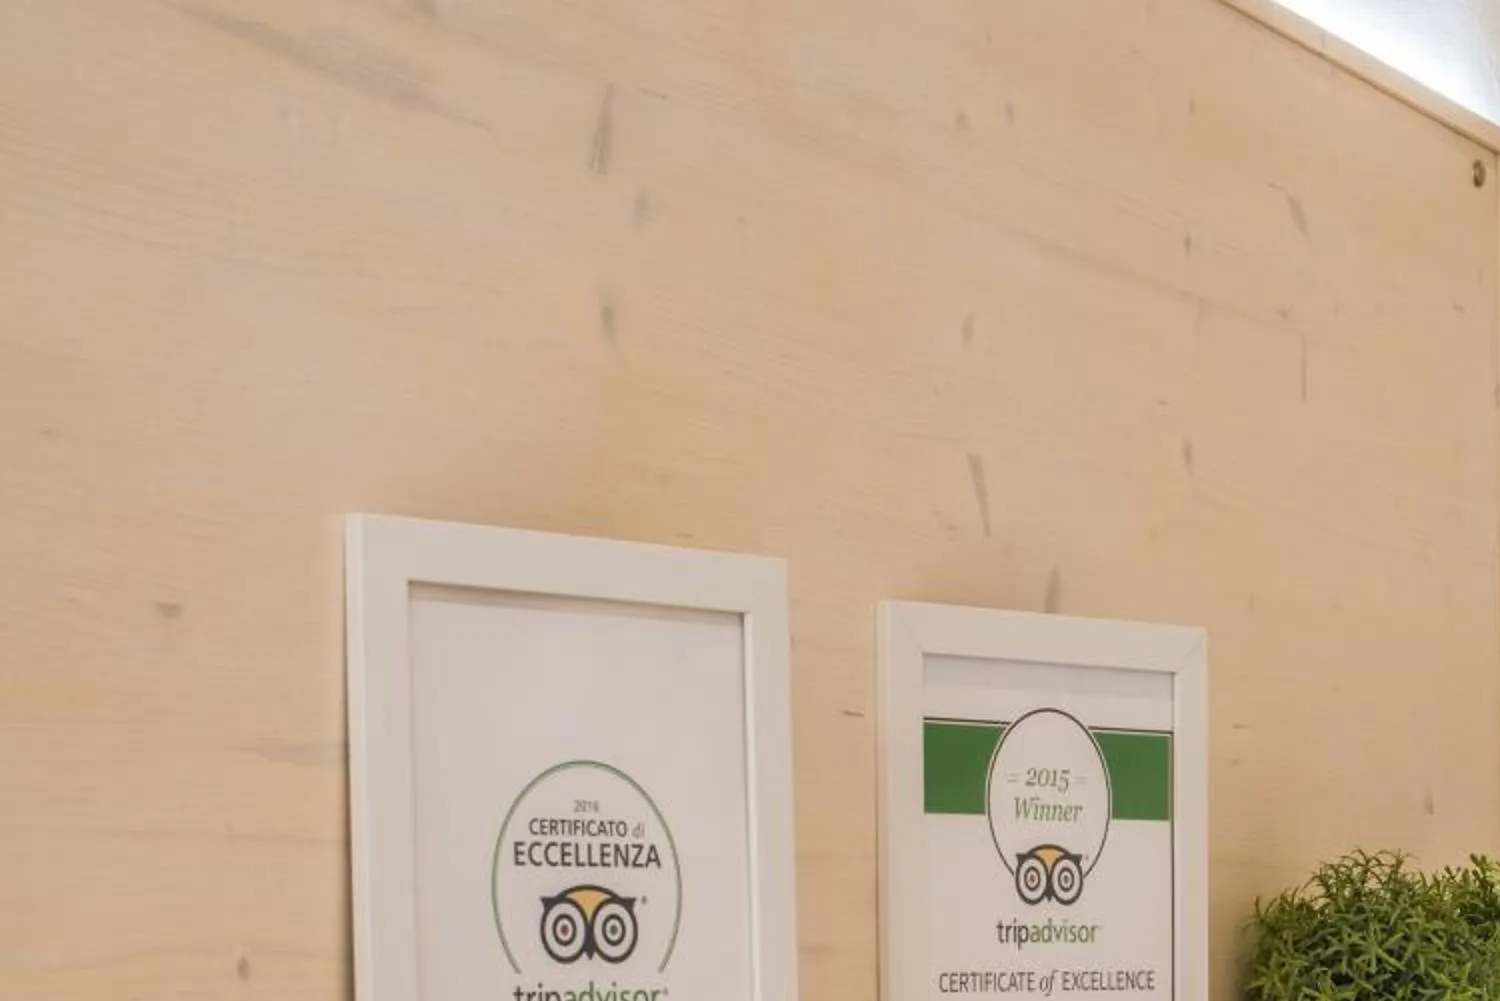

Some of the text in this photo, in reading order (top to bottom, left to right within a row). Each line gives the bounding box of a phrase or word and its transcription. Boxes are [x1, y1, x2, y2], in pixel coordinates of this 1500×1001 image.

[1025, 768, 1070, 793] 2015
[1013, 797, 1084, 823] Winner
[528, 817, 645, 839] CERTIFICATO di
[513, 841, 661, 868] ECCELLENZA
[996, 917, 1098, 950] tripadvisor
[939, 969, 1155, 997] CERTIFICATE of EXCELLENCE
